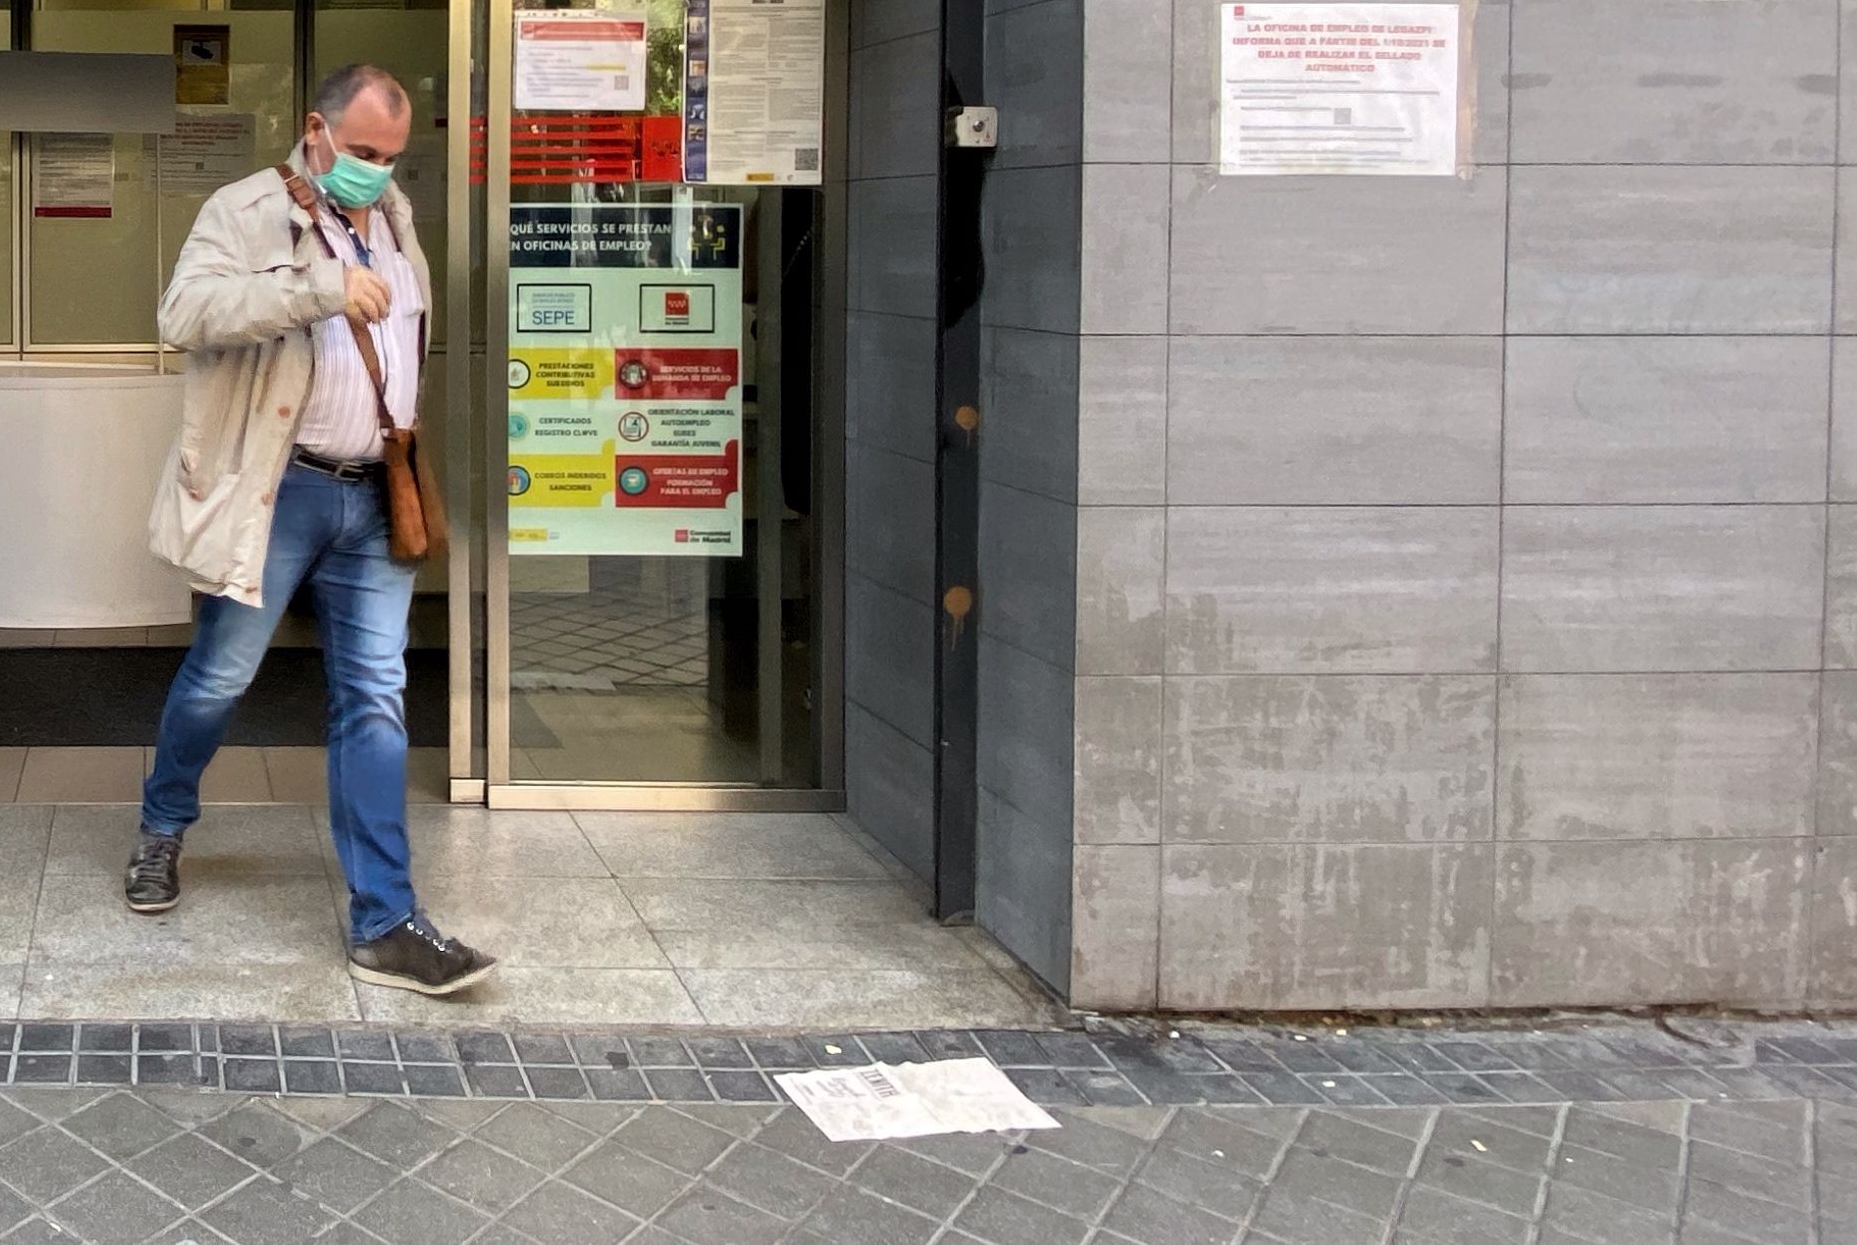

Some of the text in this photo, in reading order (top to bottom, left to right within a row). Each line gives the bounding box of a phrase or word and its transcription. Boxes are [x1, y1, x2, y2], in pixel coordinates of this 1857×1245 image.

[1247, 24, 1261, 32] LA
[1264, 24, 1307, 32] OFICINA
[1310, 24, 1324, 32] DE
[1327, 24, 1369, 33] EMPLEO
[1284, 37, 1306, 45] QUE
[1258, 50, 1284, 58] DEJA
[1287, 50, 1301, 58] DE
[1305, 51, 1355, 59] REALIZAR
[1358, 51, 1372, 59] EL
[510, 220, 671, 235] QUÉ SERVICIOS SE PRESTAN
[510, 240, 652, 251] N OFICINAS DE EMPLEO?
[532, 310, 575, 325] SEPE
